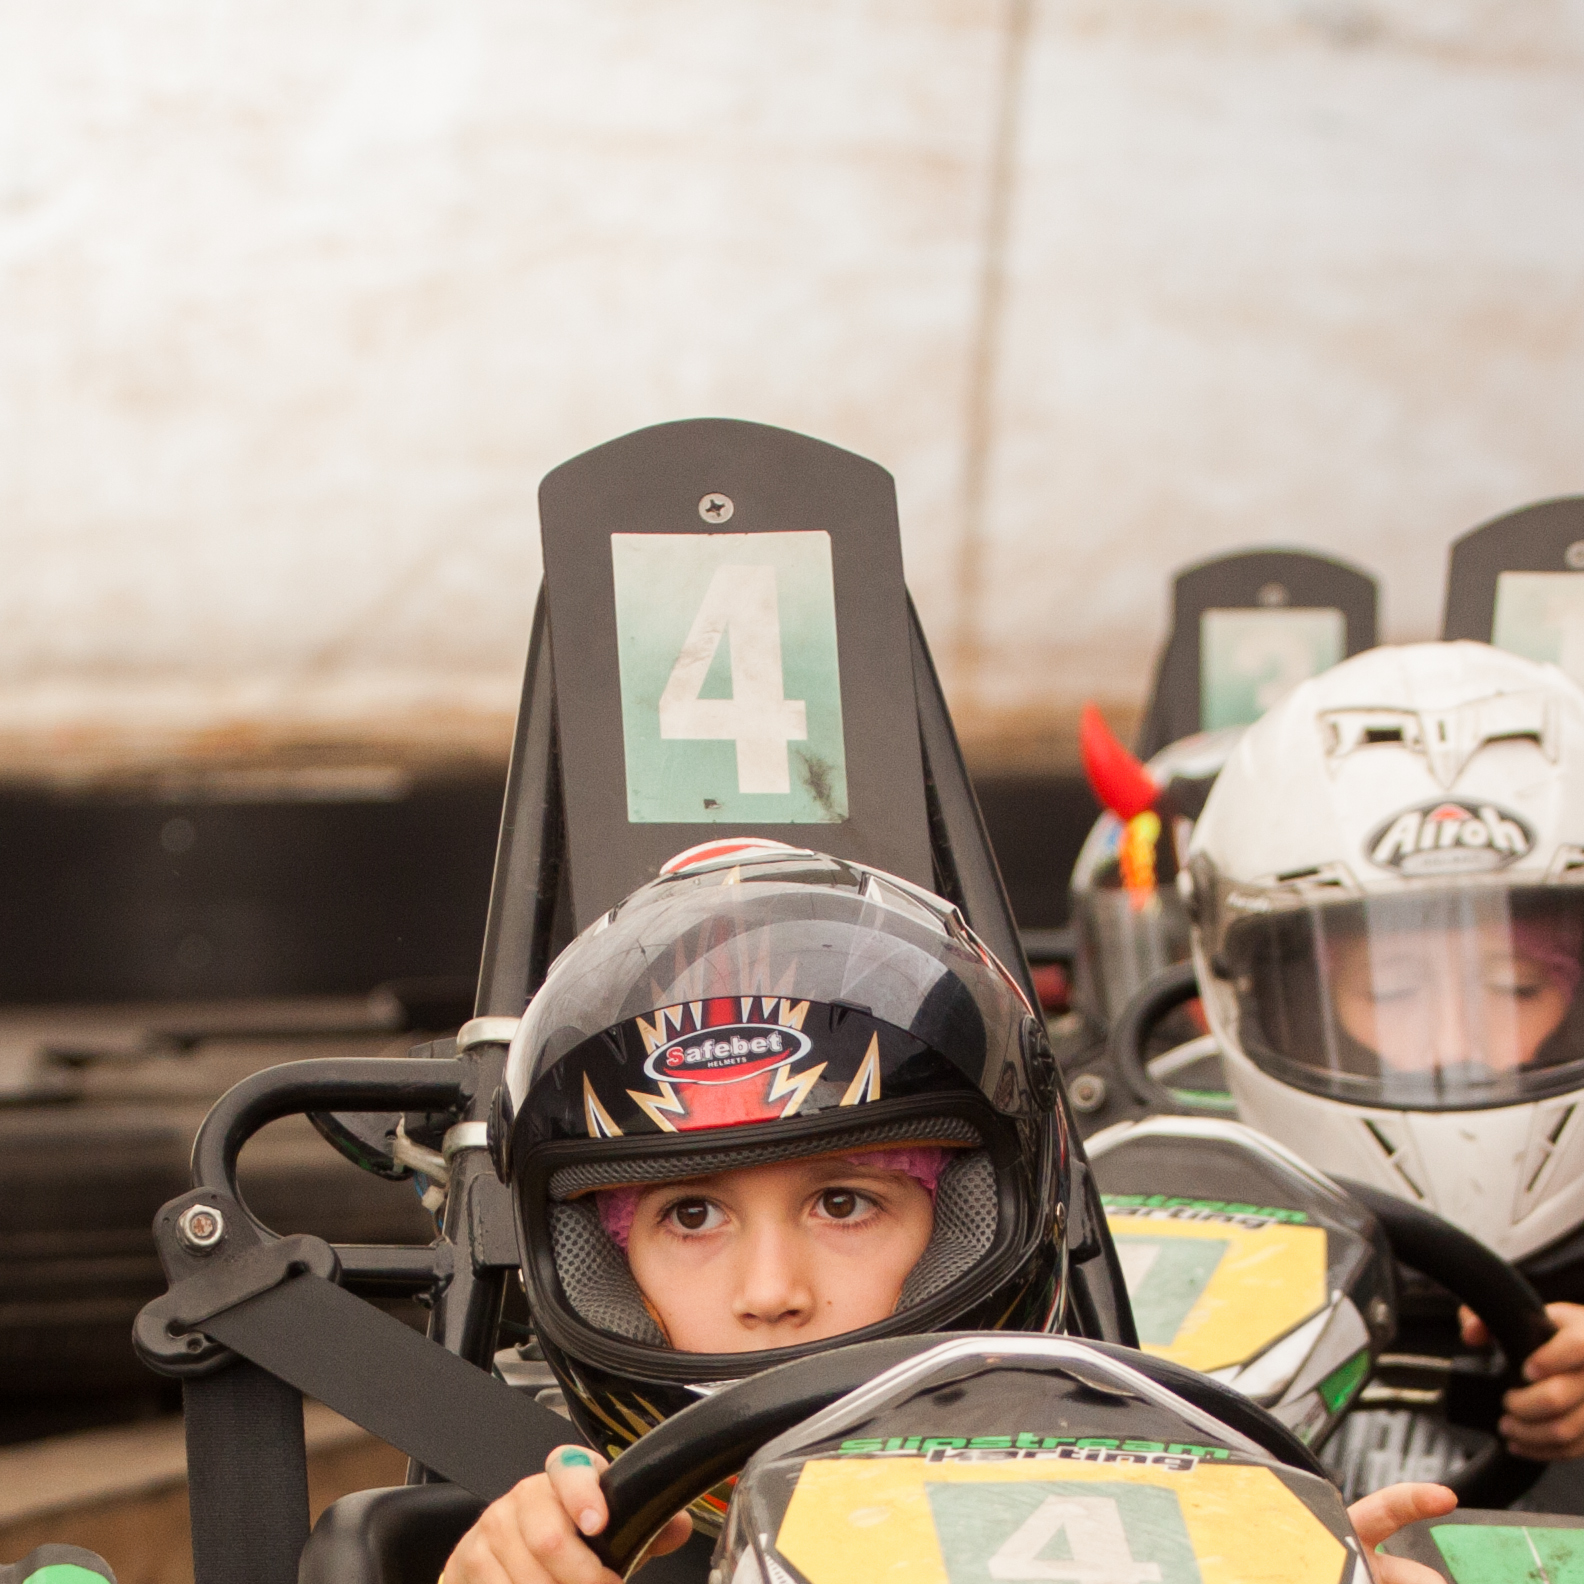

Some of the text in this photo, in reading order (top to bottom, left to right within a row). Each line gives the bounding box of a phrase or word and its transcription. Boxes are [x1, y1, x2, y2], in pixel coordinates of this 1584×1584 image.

[658, 564, 808, 794] 4
[1373, 802, 1529, 864] Airoh
[666, 1031, 783, 1067] Safebet
[707, 1056, 748, 1068] HELMETS
